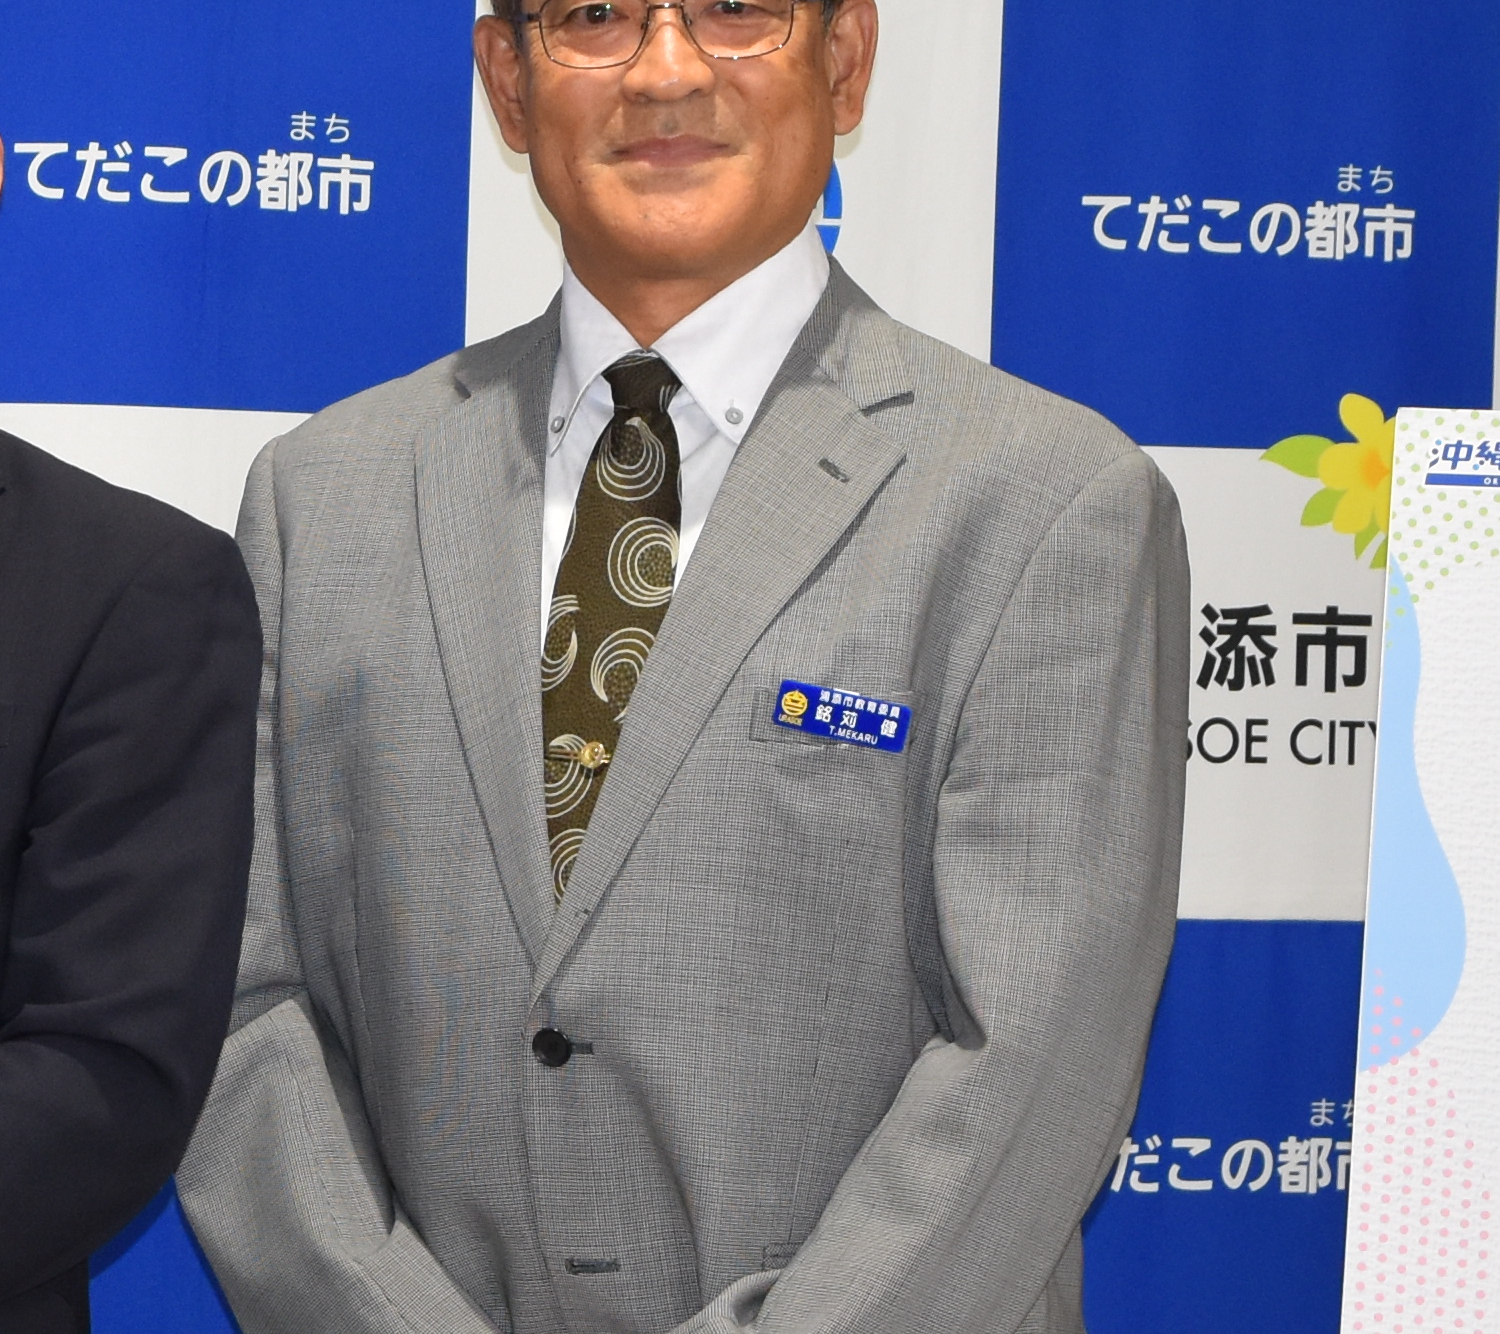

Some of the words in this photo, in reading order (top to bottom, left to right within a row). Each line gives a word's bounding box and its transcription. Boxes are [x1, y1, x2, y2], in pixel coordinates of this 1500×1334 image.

[290, 111, 349, 142] まち
[14, 141, 374, 214] てだこの都市
[1338, 164, 1393, 193] まち
[1082, 195, 1415, 261] てだこの都市
[1196, 604, 1372, 692] 添市
[829, 725, 878, 745] T.MEKARU
[1110, 1134, 1351, 1194] だこの都
